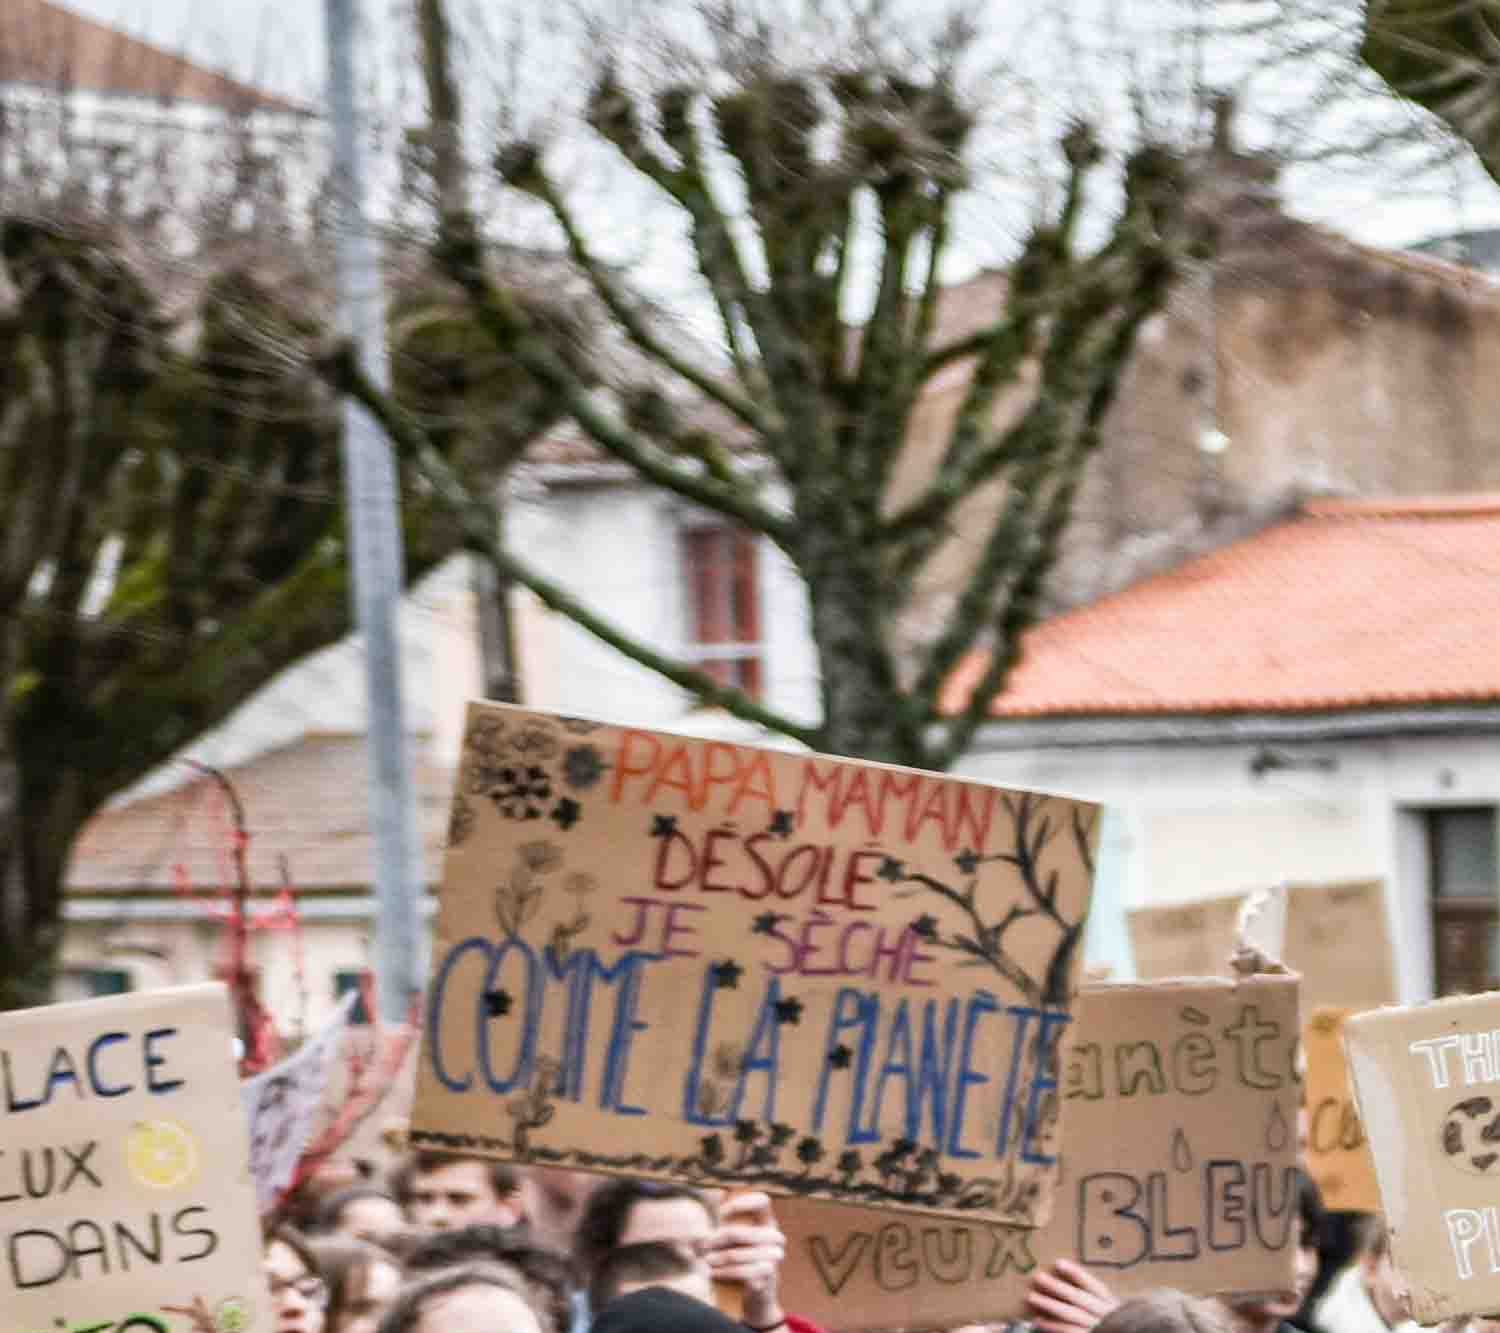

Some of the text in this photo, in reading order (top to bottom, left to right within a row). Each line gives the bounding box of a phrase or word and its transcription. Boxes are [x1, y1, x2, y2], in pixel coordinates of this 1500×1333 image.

[611, 729, 996, 851] PAPA MAMAN
[654, 821, 886, 910] DÉSOLÉ
[611, 897, 937, 986] JE SÈCHE
[430, 935, 1072, 1165] COMME LA PLANÈTE
[1067, 1004, 1303, 1101] anèt
[9, 1206, 220, 1289] DANS
